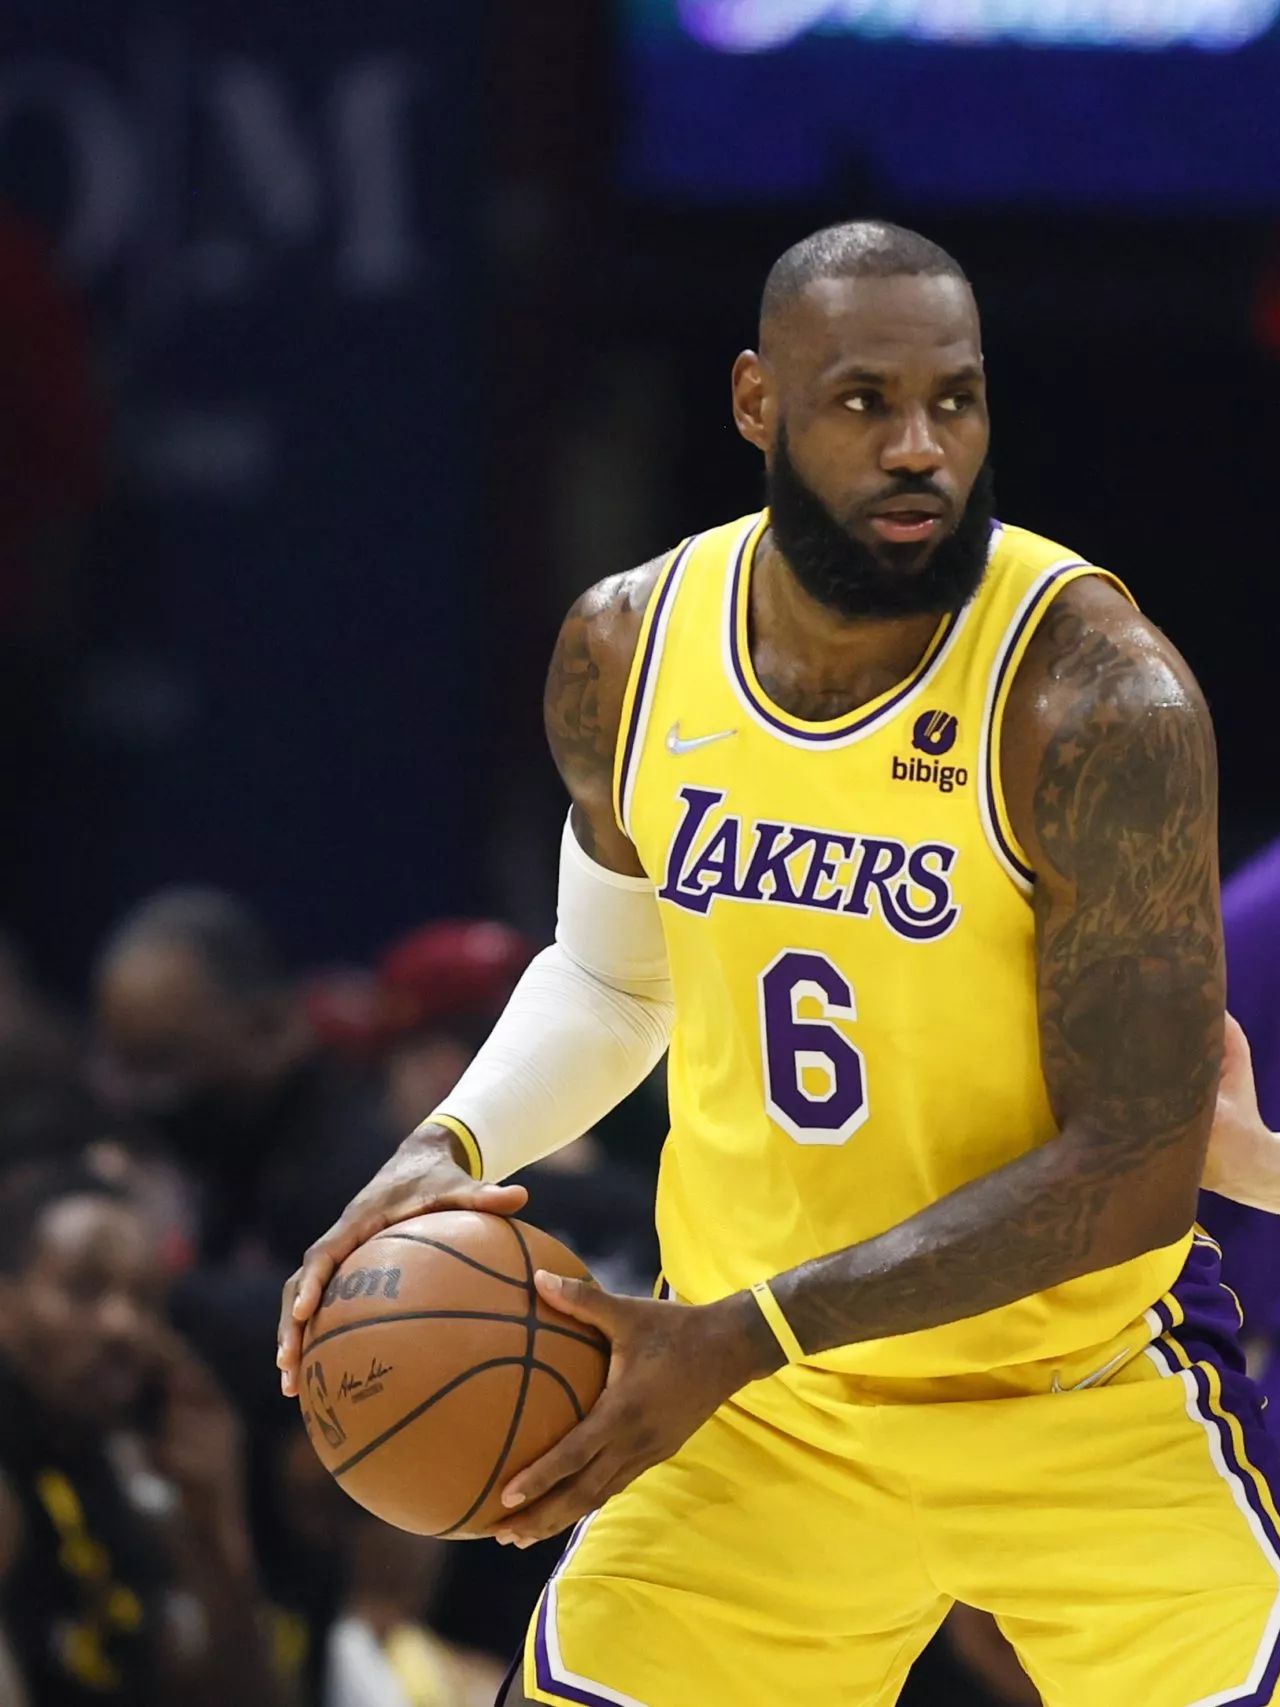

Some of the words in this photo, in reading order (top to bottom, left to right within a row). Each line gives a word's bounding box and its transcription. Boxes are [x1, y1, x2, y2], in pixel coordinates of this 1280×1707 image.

[892, 756, 968, 793] bibigo
[656, 783, 961, 944] LAKERS
[757, 947, 870, 1146] 6
